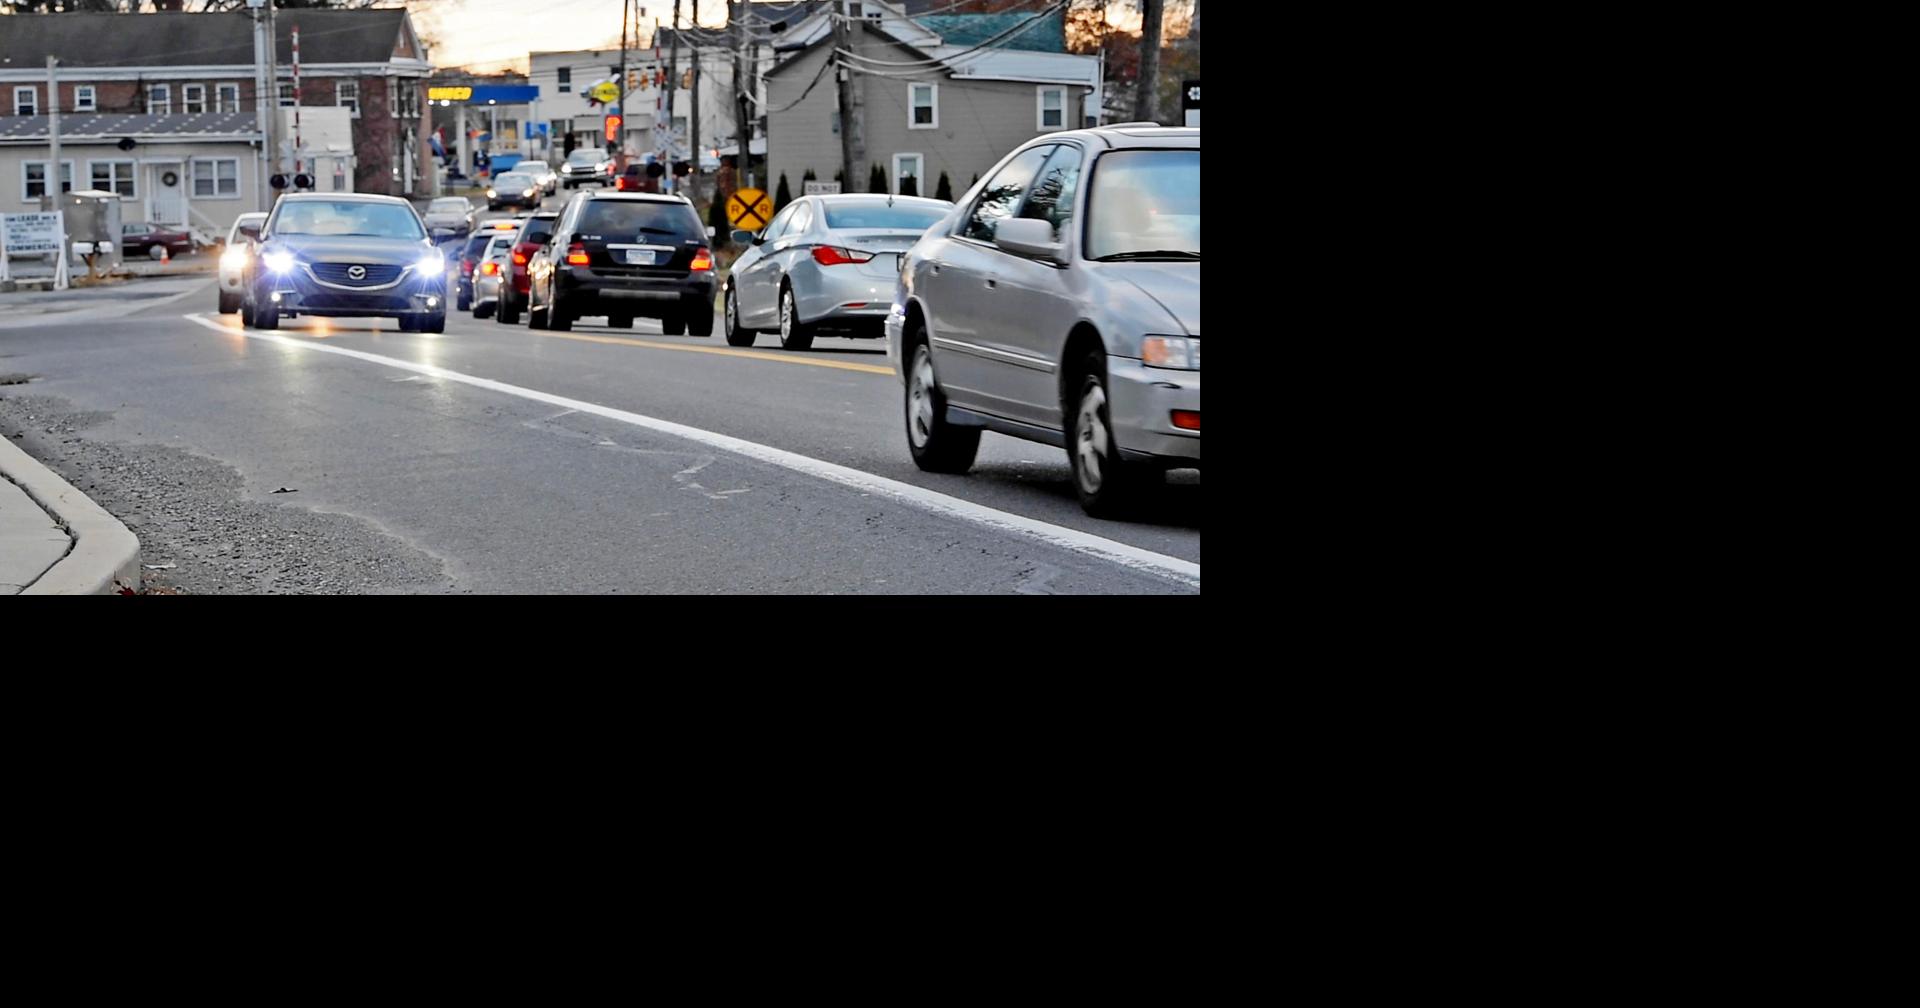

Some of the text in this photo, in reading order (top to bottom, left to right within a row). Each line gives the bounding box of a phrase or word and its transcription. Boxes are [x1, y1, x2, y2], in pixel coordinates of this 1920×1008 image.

[807, 183, 838, 192] DO NOT
[731, 204, 740, 214] R
[760, 204, 768, 214] R
